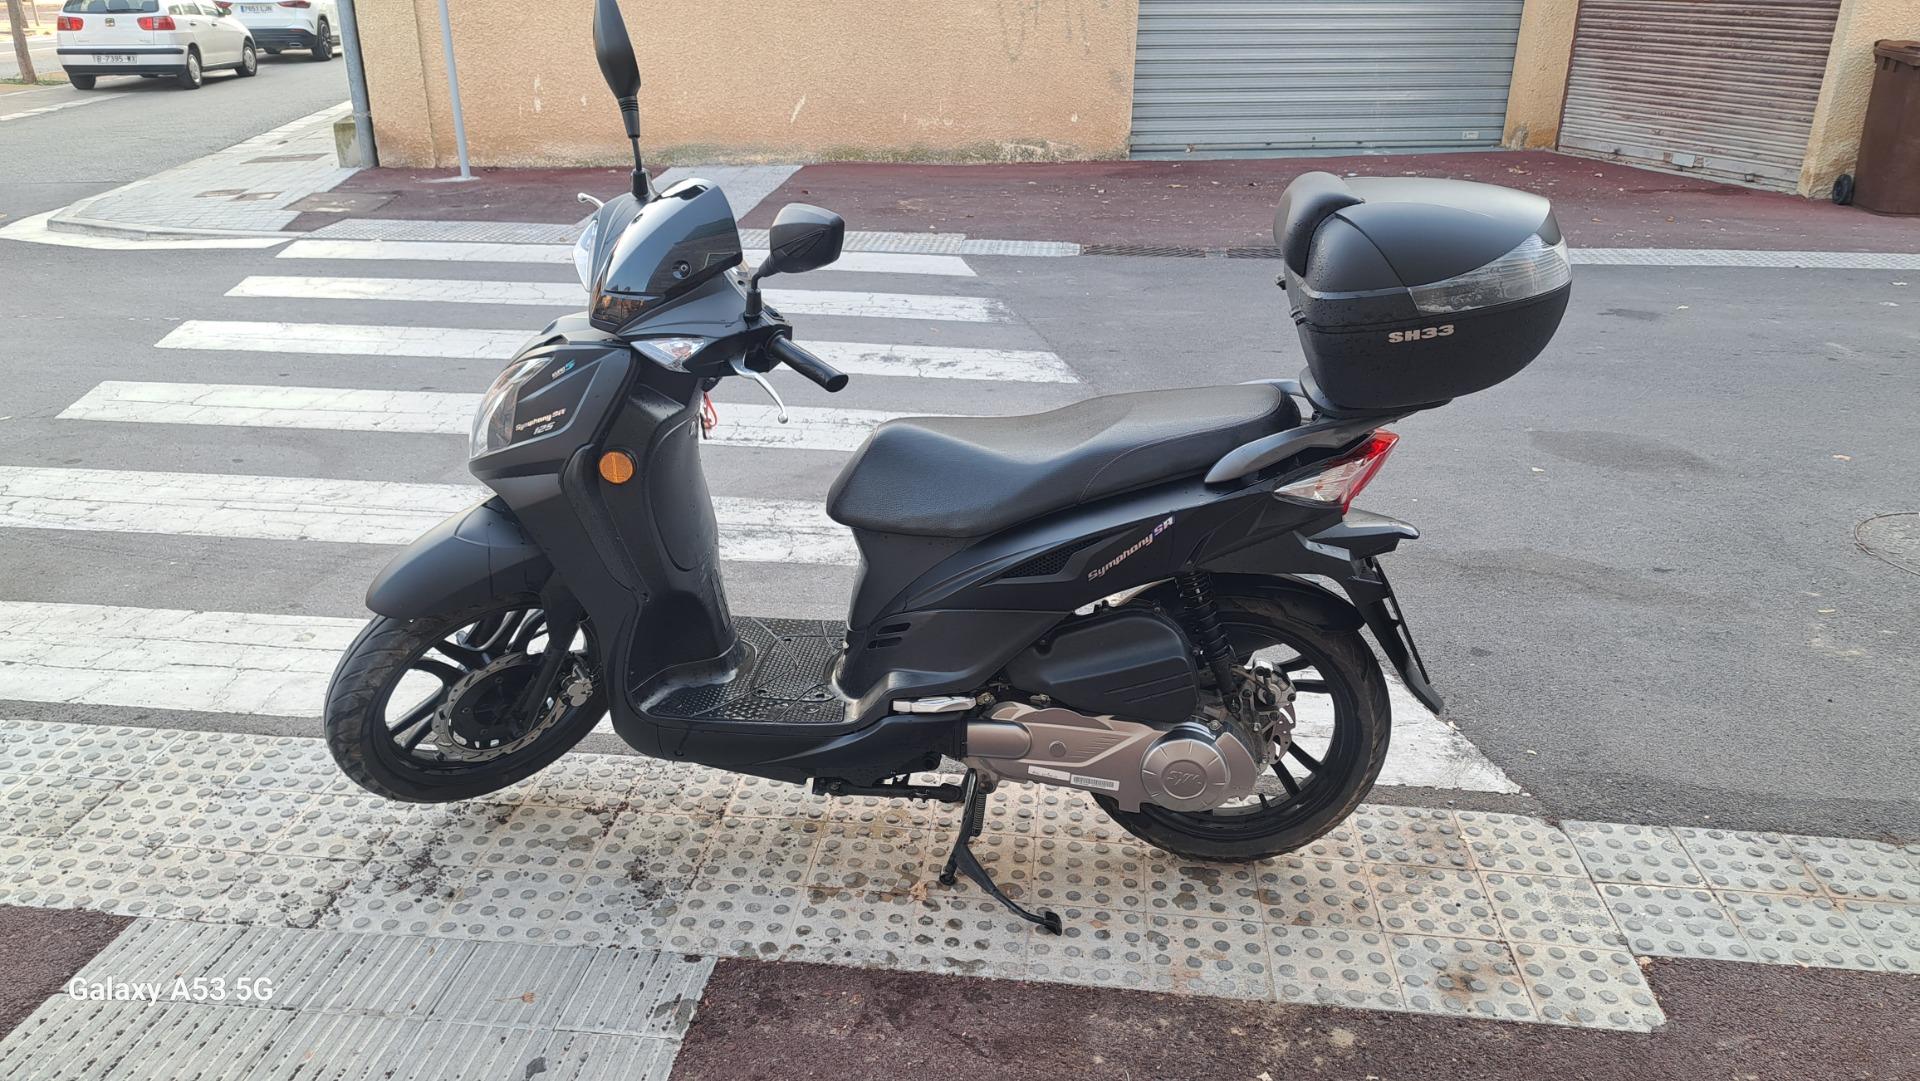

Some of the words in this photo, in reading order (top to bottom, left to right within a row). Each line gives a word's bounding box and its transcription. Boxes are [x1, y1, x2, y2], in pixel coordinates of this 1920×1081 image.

[1388, 323, 1455, 343] SH33
[533, 421, 556, 436] 125
[1087, 533, 1153, 581] Symphony
